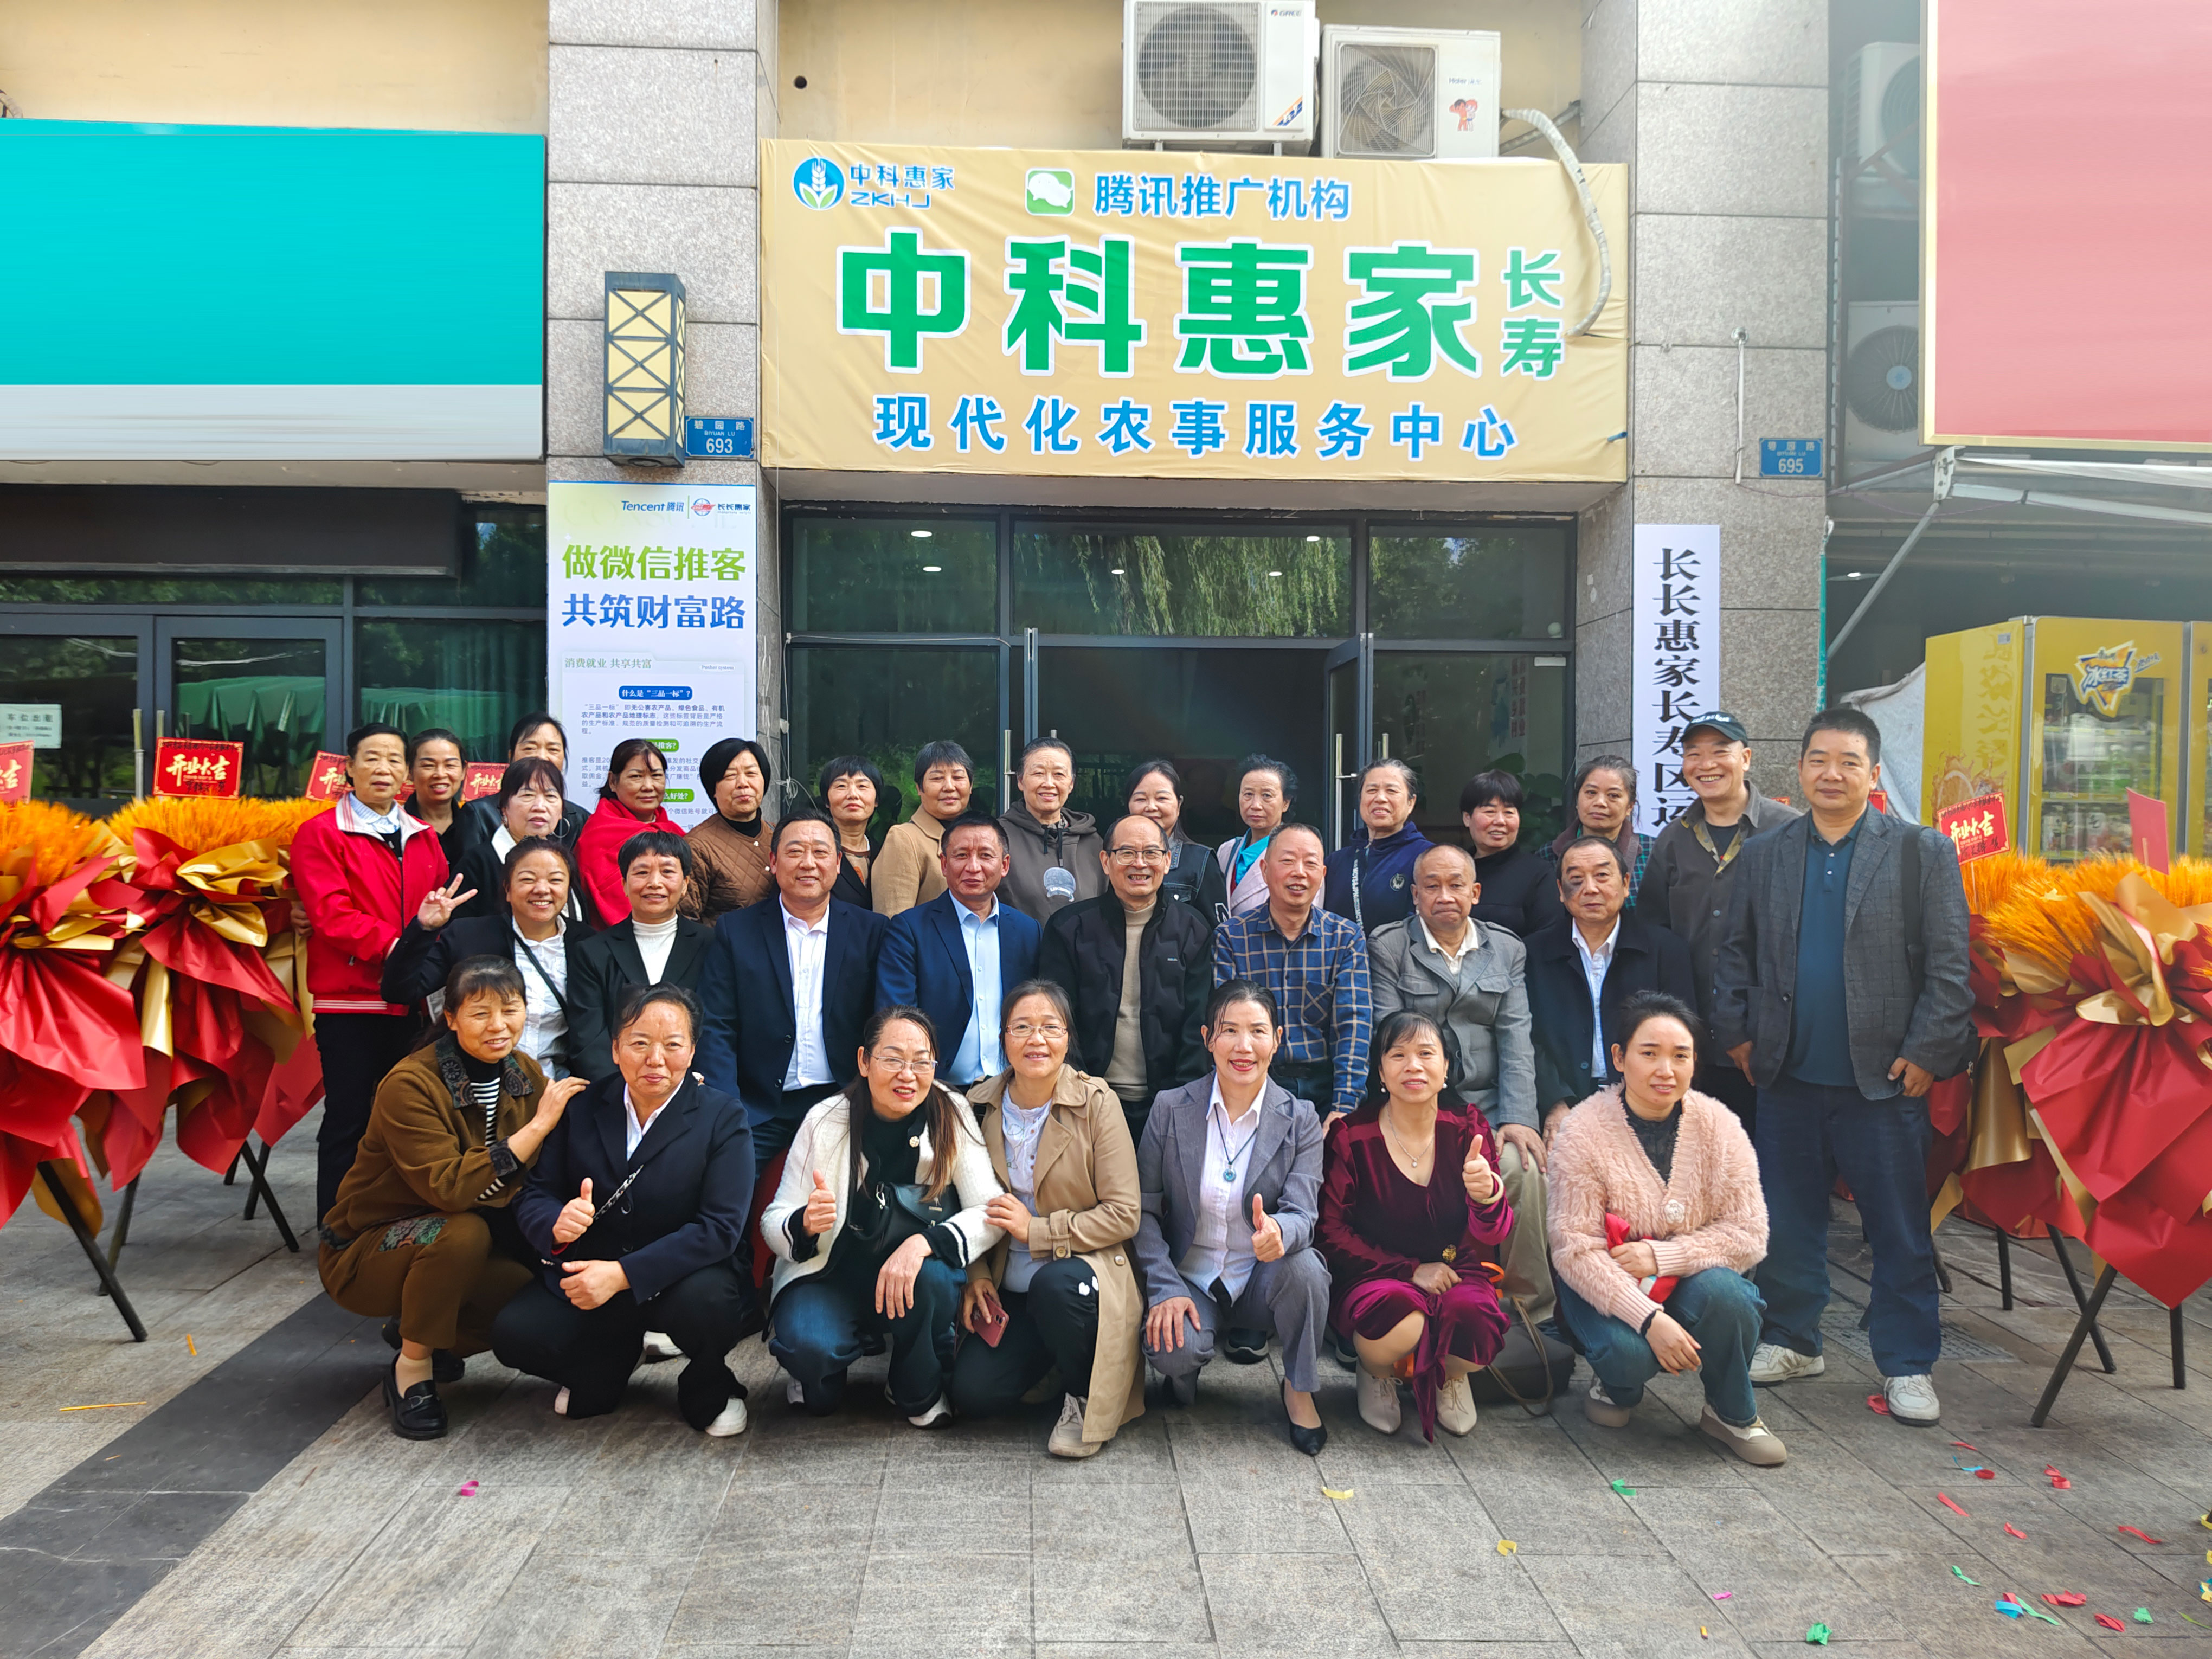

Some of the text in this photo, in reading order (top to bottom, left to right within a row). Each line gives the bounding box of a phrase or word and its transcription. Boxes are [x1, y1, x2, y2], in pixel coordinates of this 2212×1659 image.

[850, 164, 955, 190] 中科惠家
[850, 191, 931, 208] ZKHJ
[1094, 174, 1350, 221] 腾讯推广机构
[838, 228, 1481, 380] 中科惠家
[1501, 249, 1563, 379] 长寿
[874, 394, 1519, 459] 现代化农事服务中心
[706, 438, 733, 454] 693
[1778, 458, 1803, 473] 695
[621, 500, 666, 512] Tencent
[666, 501, 685, 512] 腾讯
[562, 544, 746, 581] 做微信推客
[562, 593, 746, 629] 共筑财富路
[564, 657, 652, 670] 消费就业 共享共富
[165, 753, 231, 787] 开业大吉
[1950, 810, 1995, 856] 开业大吉
